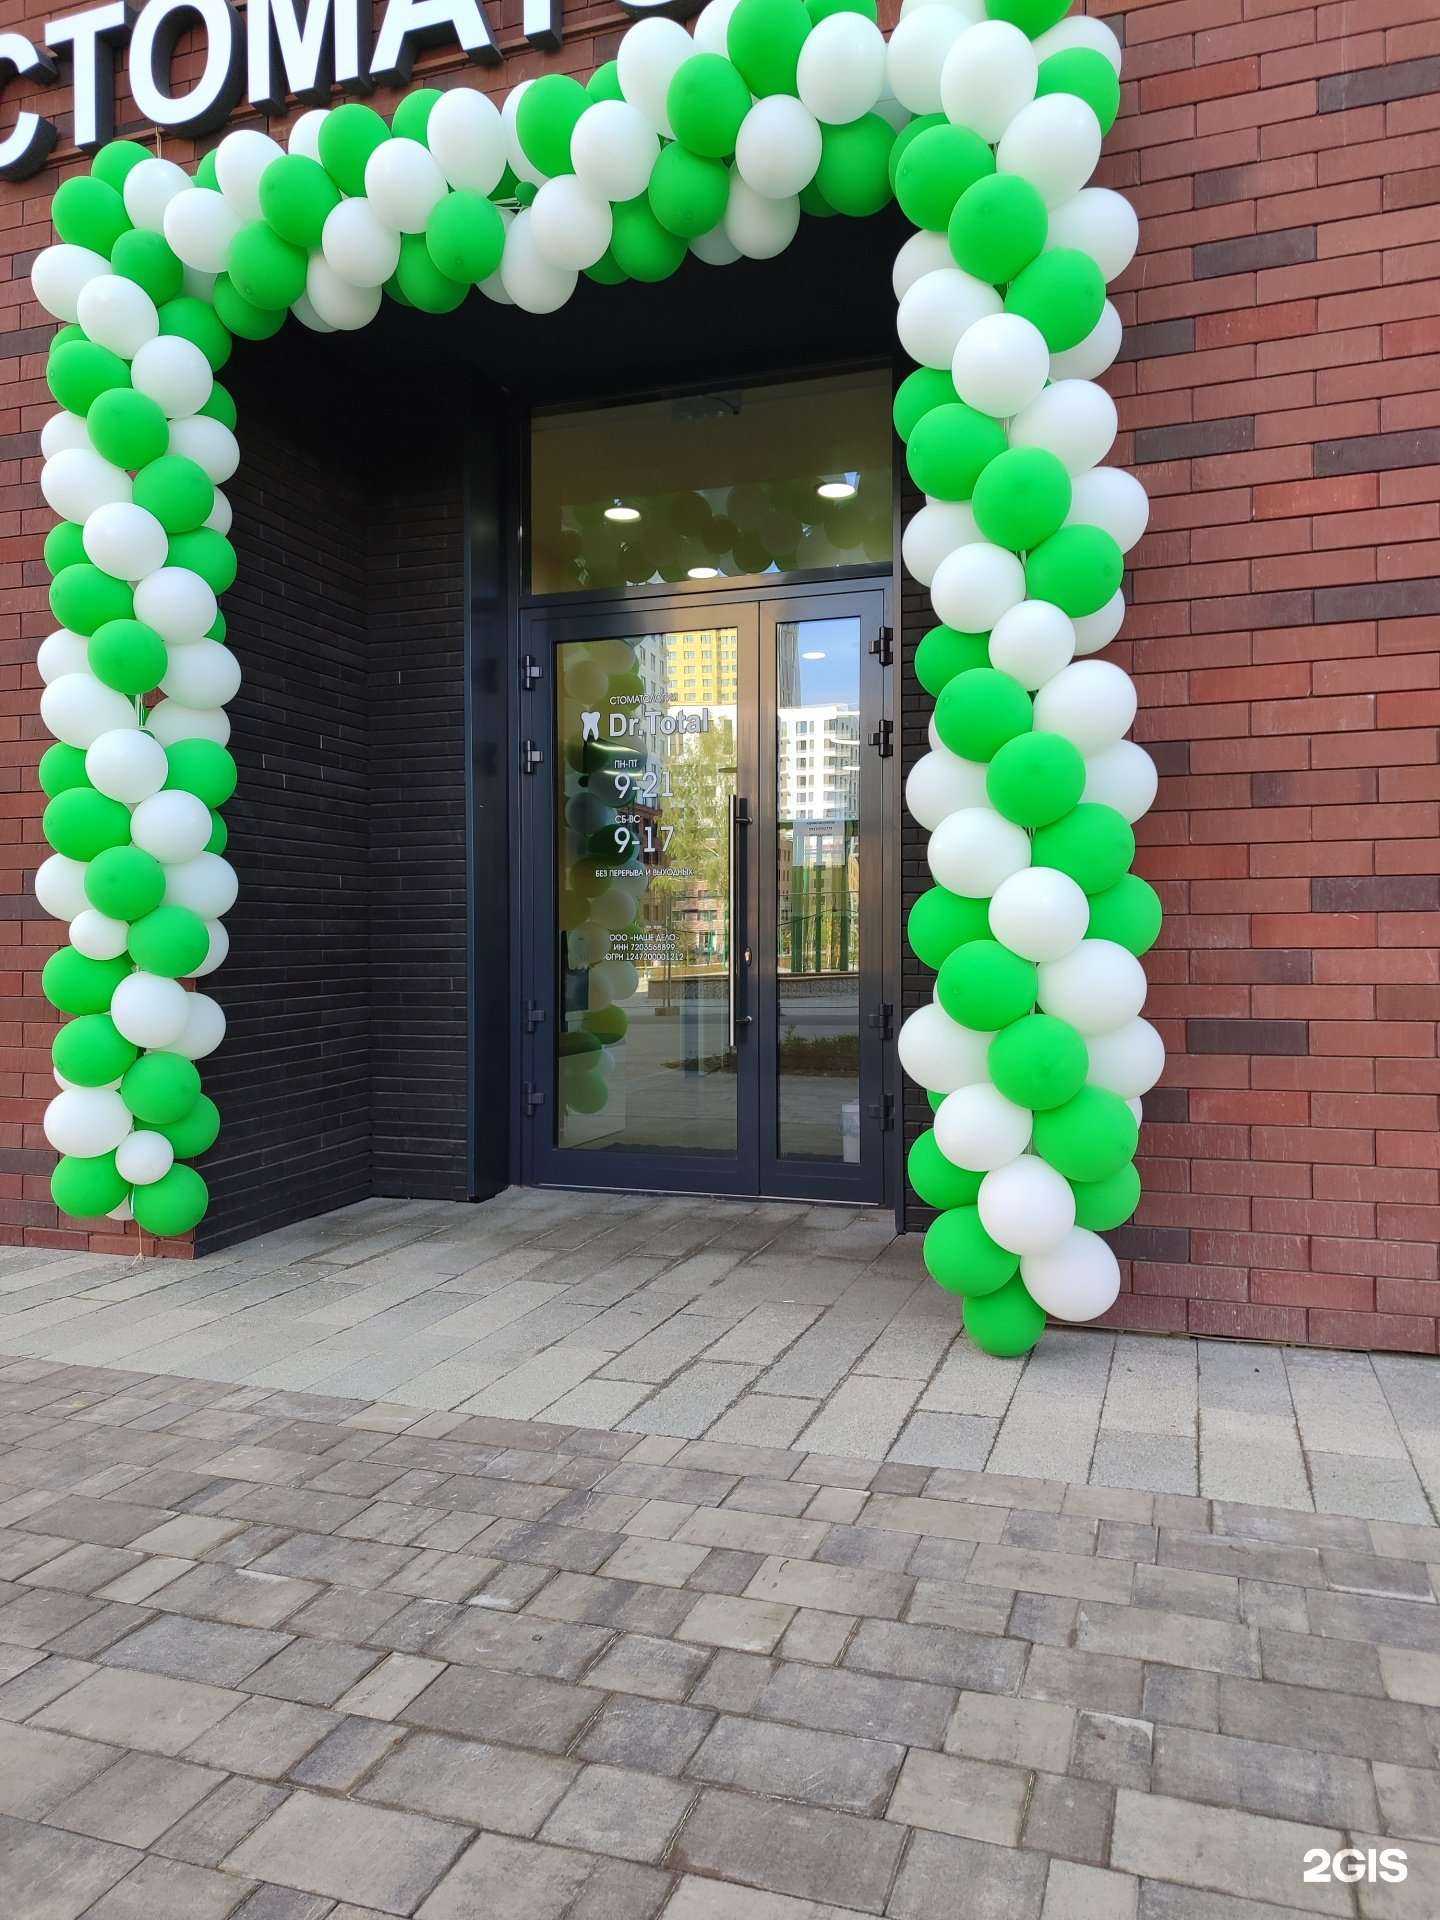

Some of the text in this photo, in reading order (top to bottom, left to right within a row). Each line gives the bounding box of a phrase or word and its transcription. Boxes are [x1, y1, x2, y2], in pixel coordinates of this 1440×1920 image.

[0, 0, 673, 169] ТОМА
[609, 708, 709, 737] Dr.Total
[614, 759, 638, 769] ПН-ПТ
[614, 771, 674, 799] 9-21
[615, 814, 641, 824] СБ-ВС
[614, 826, 674, 853] 9-17
[595, 867, 693, 878] БЕЗ ПЕРЕРЫВА И ВЫХОДНЫХ
[609, 934, 628, 942] ООО
[613, 943, 629, 951] ИНН
[605, 953, 624, 961] ОГРН
